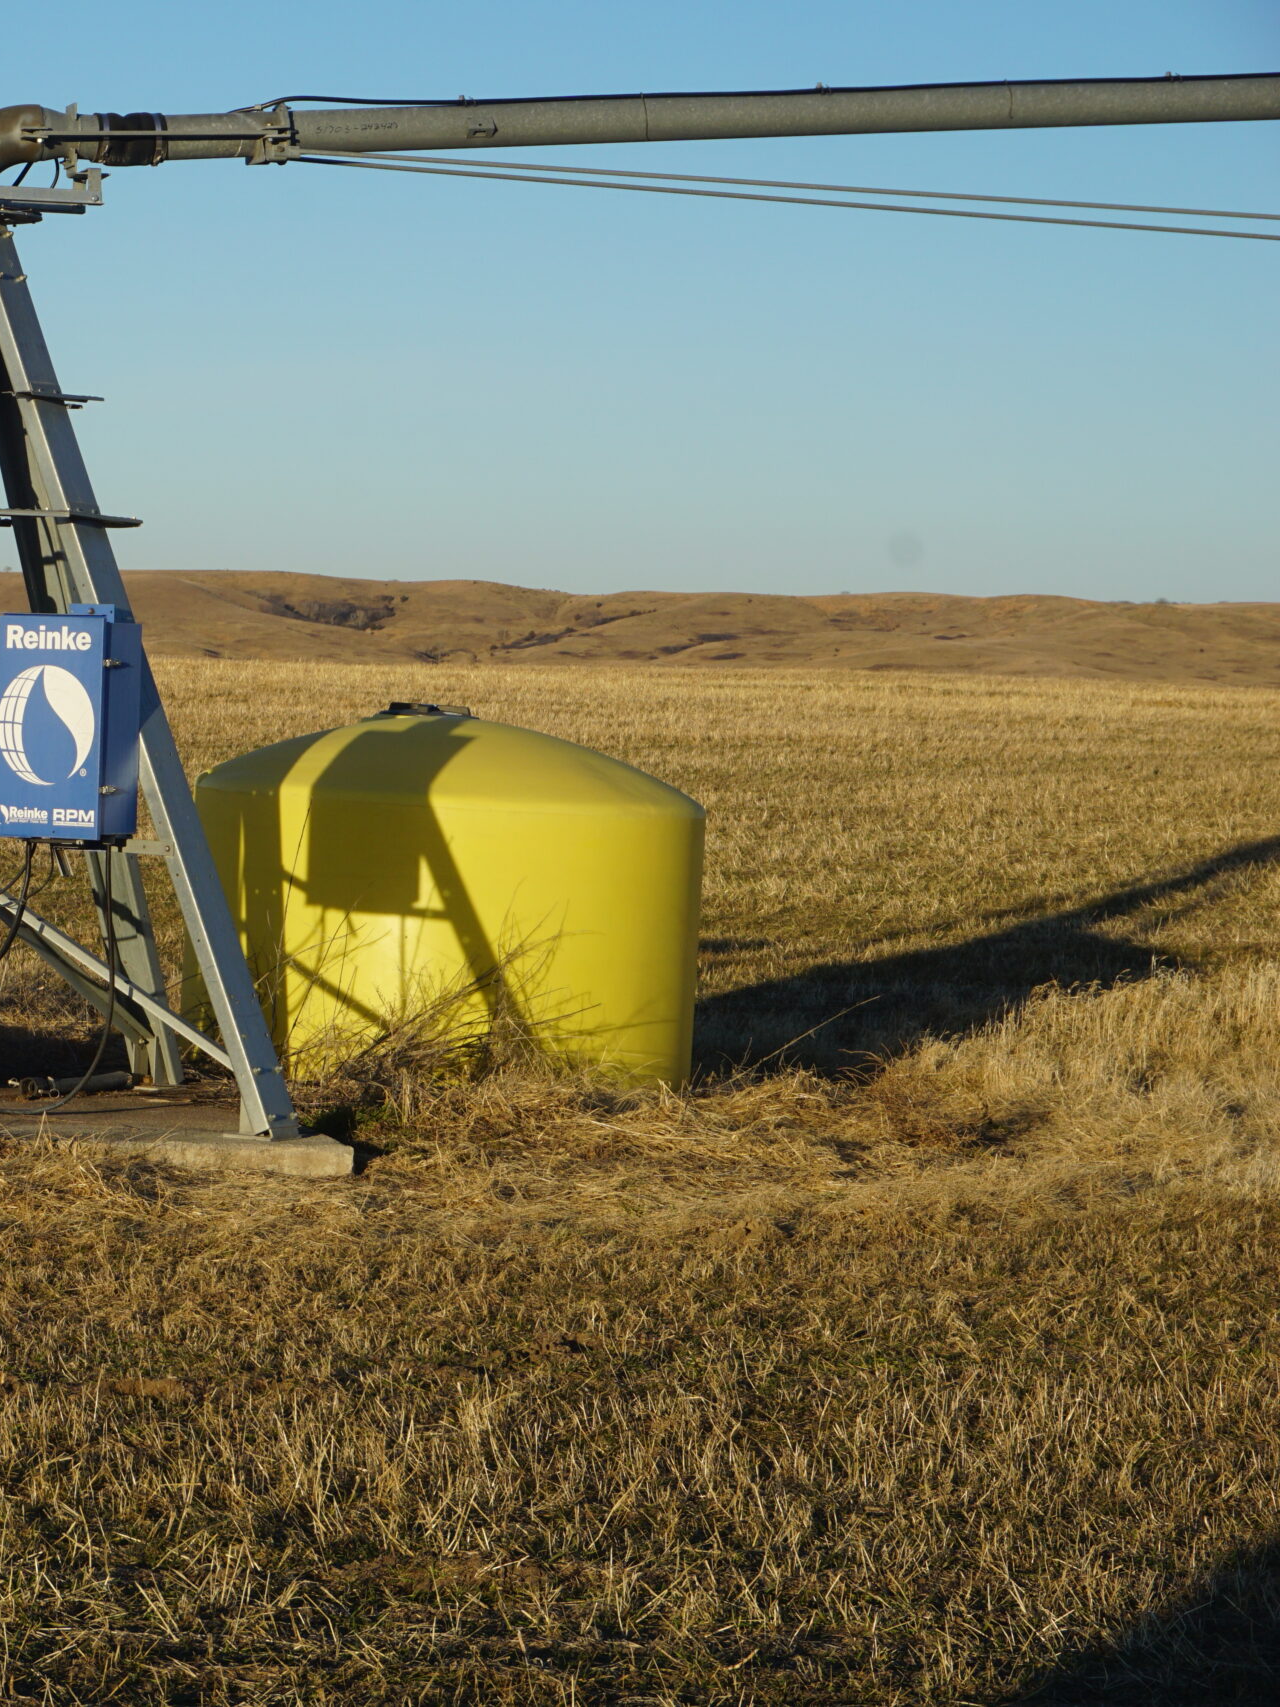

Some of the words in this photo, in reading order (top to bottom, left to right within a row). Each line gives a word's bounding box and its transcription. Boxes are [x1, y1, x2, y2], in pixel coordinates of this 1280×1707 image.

[6, 624, 92, 651] Reinke
[9, 805, 48, 819] Reinke
[52, 808, 95, 822] RPM
